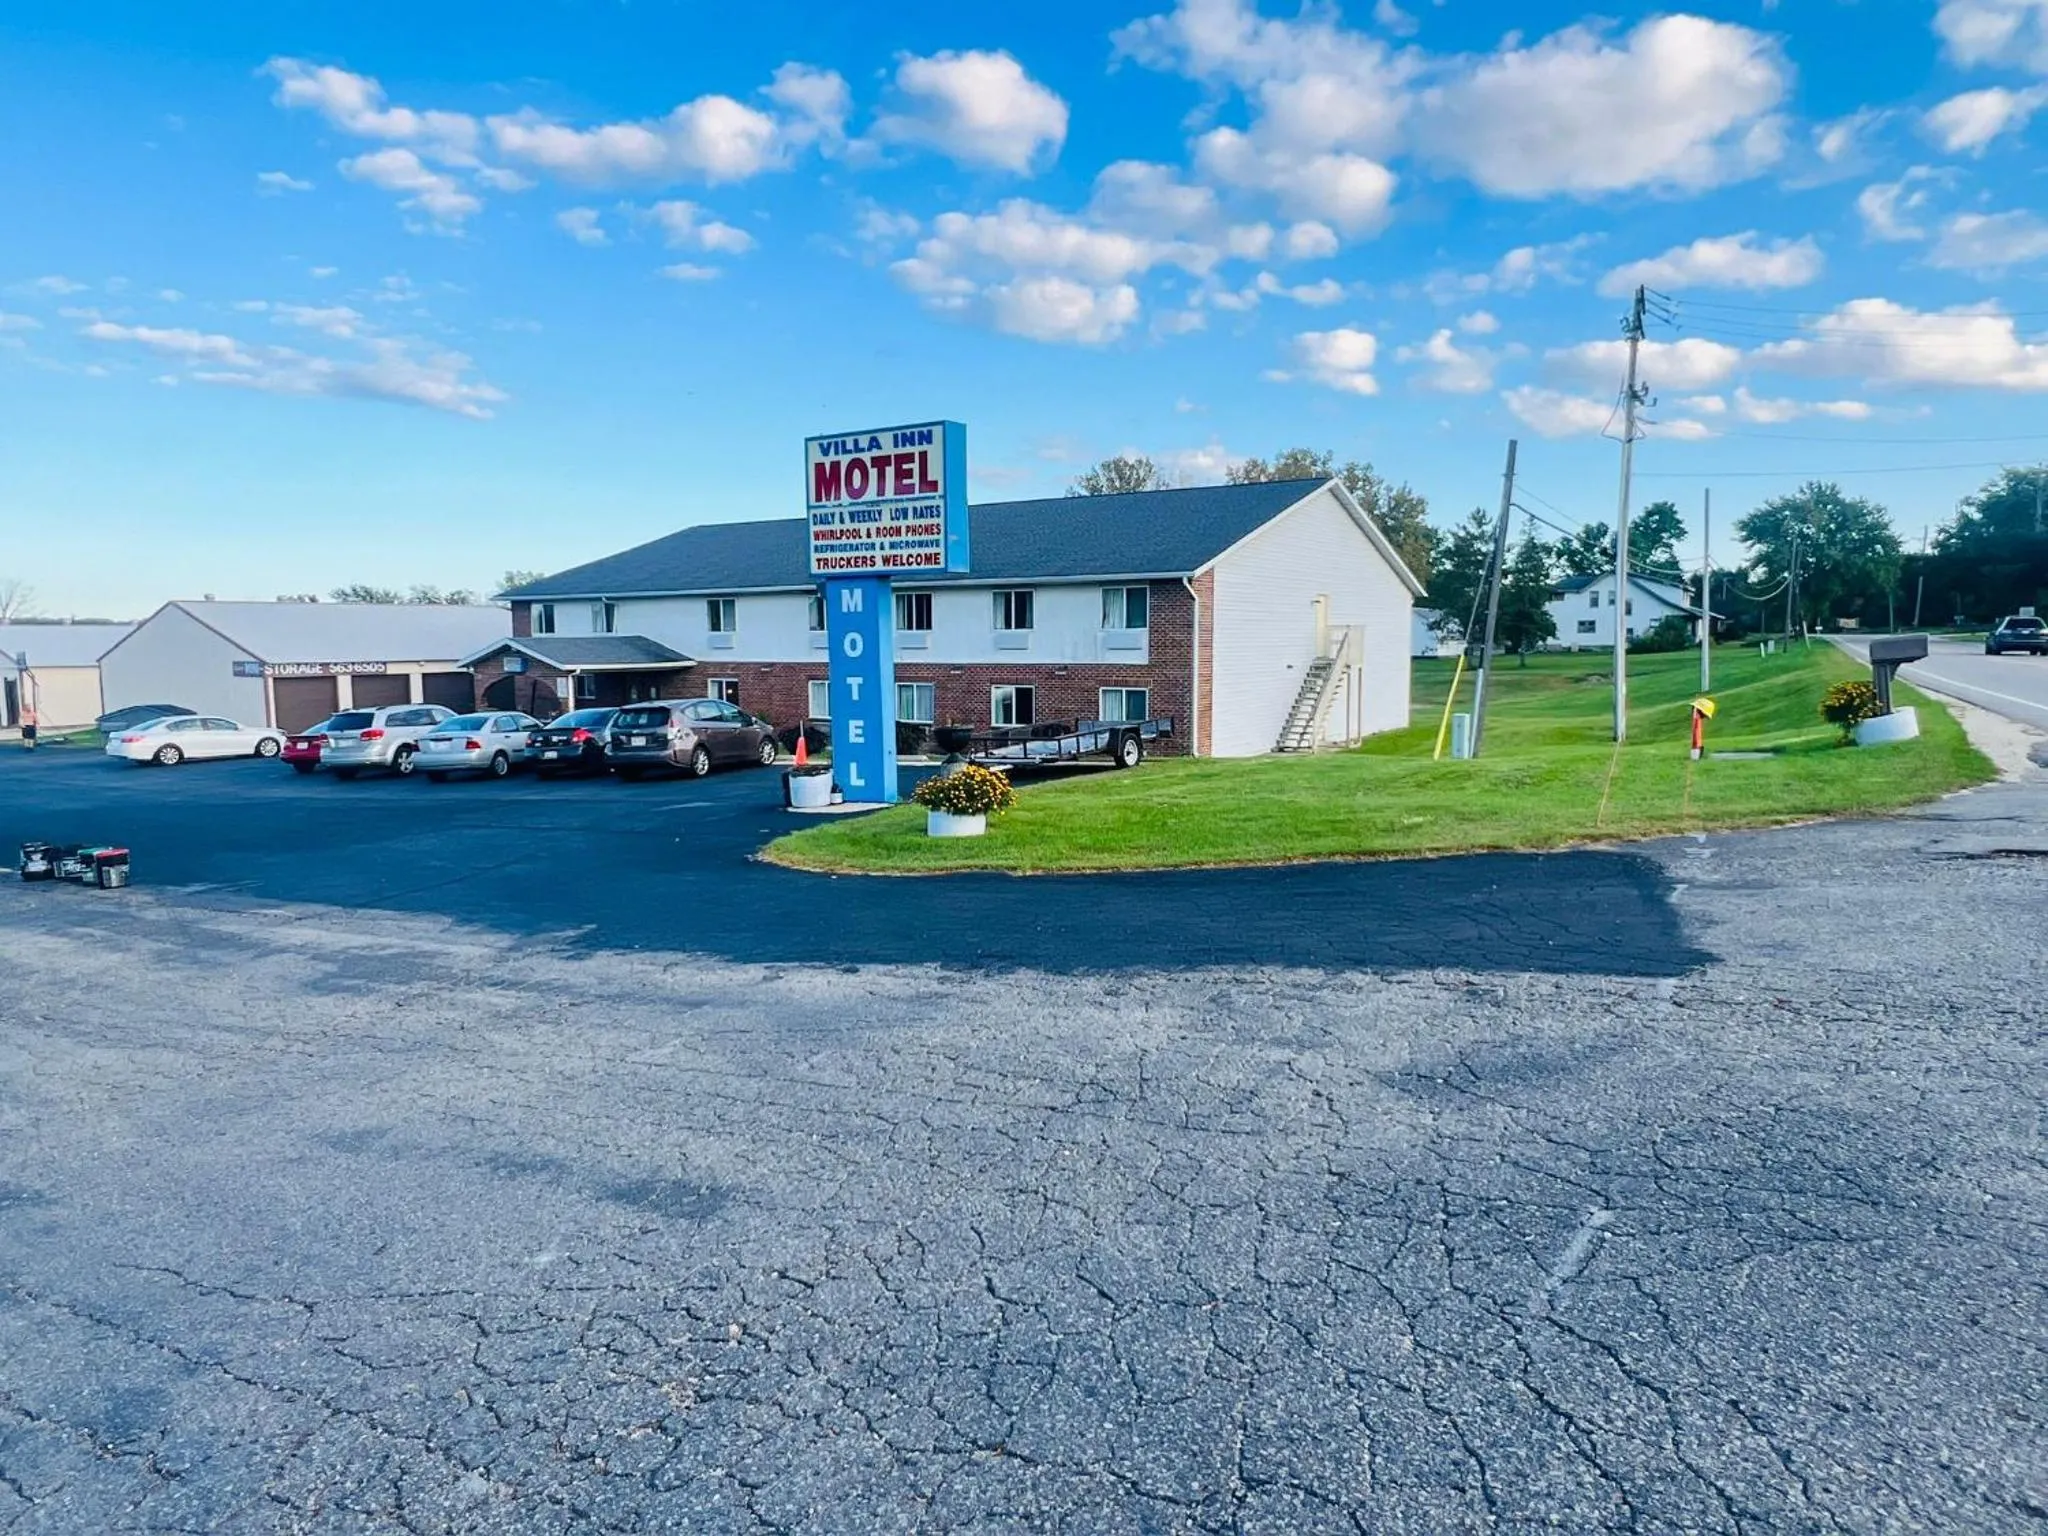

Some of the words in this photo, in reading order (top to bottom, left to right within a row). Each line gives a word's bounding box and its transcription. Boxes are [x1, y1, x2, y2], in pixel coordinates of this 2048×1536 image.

[819, 436, 882, 457] VILLA
[893, 429, 933, 448] INN
[814, 451, 939, 503] MOTEL
[813, 511, 836, 526] DAILY
[839, 510, 845, 524] &
[848, 508, 883, 524] WEEKLY
[890, 506, 909, 521] LOW
[912, 505, 941, 520] RATES
[813, 527, 862, 541] WHIRLPOOL
[866, 527, 872, 538] &
[876, 525, 902, 538] ROOM
[905, 523, 941, 537] PHONES
[814, 541, 876, 553] REFRIGERATOR
[880, 541, 885, 551] &
[889, 538, 940, 551] MICROWAVE
[816, 555, 876, 570] TRUCKERS
[882, 552, 941, 567] WELCOME
[264, 663, 323, 675] STORAGE
[840, 588, 865, 787] MOTEL
